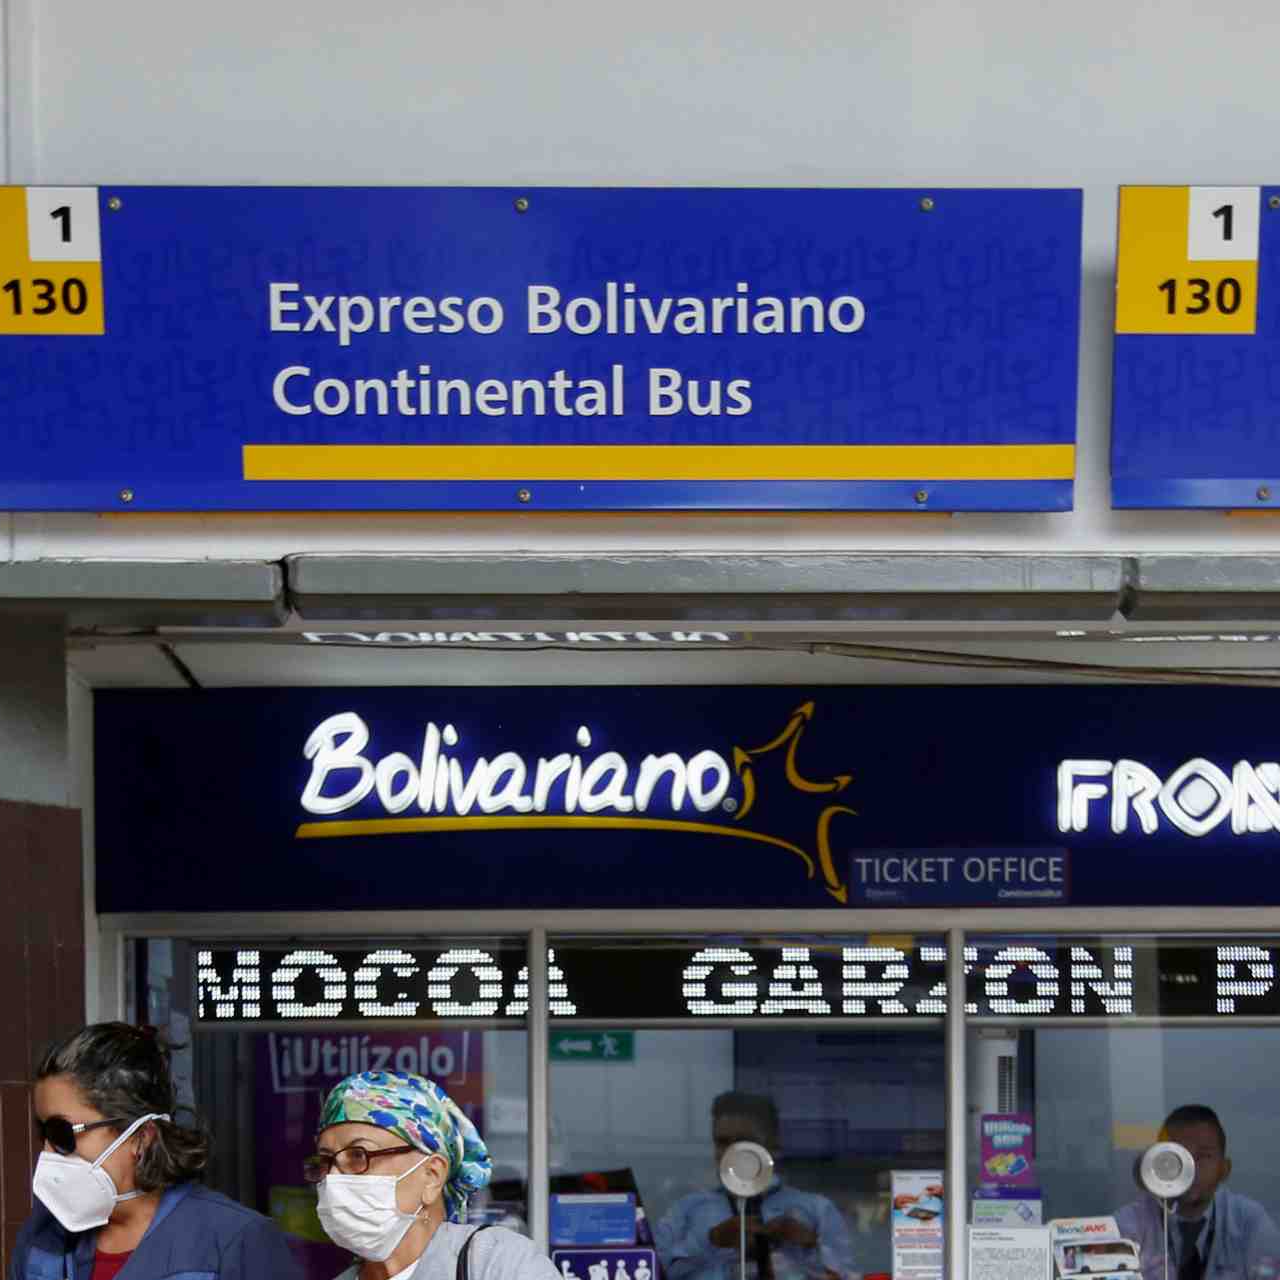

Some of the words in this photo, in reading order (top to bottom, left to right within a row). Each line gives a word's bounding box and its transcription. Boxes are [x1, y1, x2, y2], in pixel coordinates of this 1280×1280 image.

[50, 206, 71, 243] 1
[1213, 204, 1233, 241] 1
[2, 277, 88, 315] 130
[268, 282, 504, 346] Expreso
[527, 281, 866, 334] Bolivariano
[1158, 277, 1241, 315] 130
[272, 364, 625, 416] Continental
[649, 367, 753, 416] Bus
[300, 711, 729, 816] Bolivariano
[855, 857, 955, 883] TICKET
[963, 856, 1064, 883] OFFICE
[197, 948, 578, 1018] MOCOA
[681, 946, 1133, 1015] GARZON
